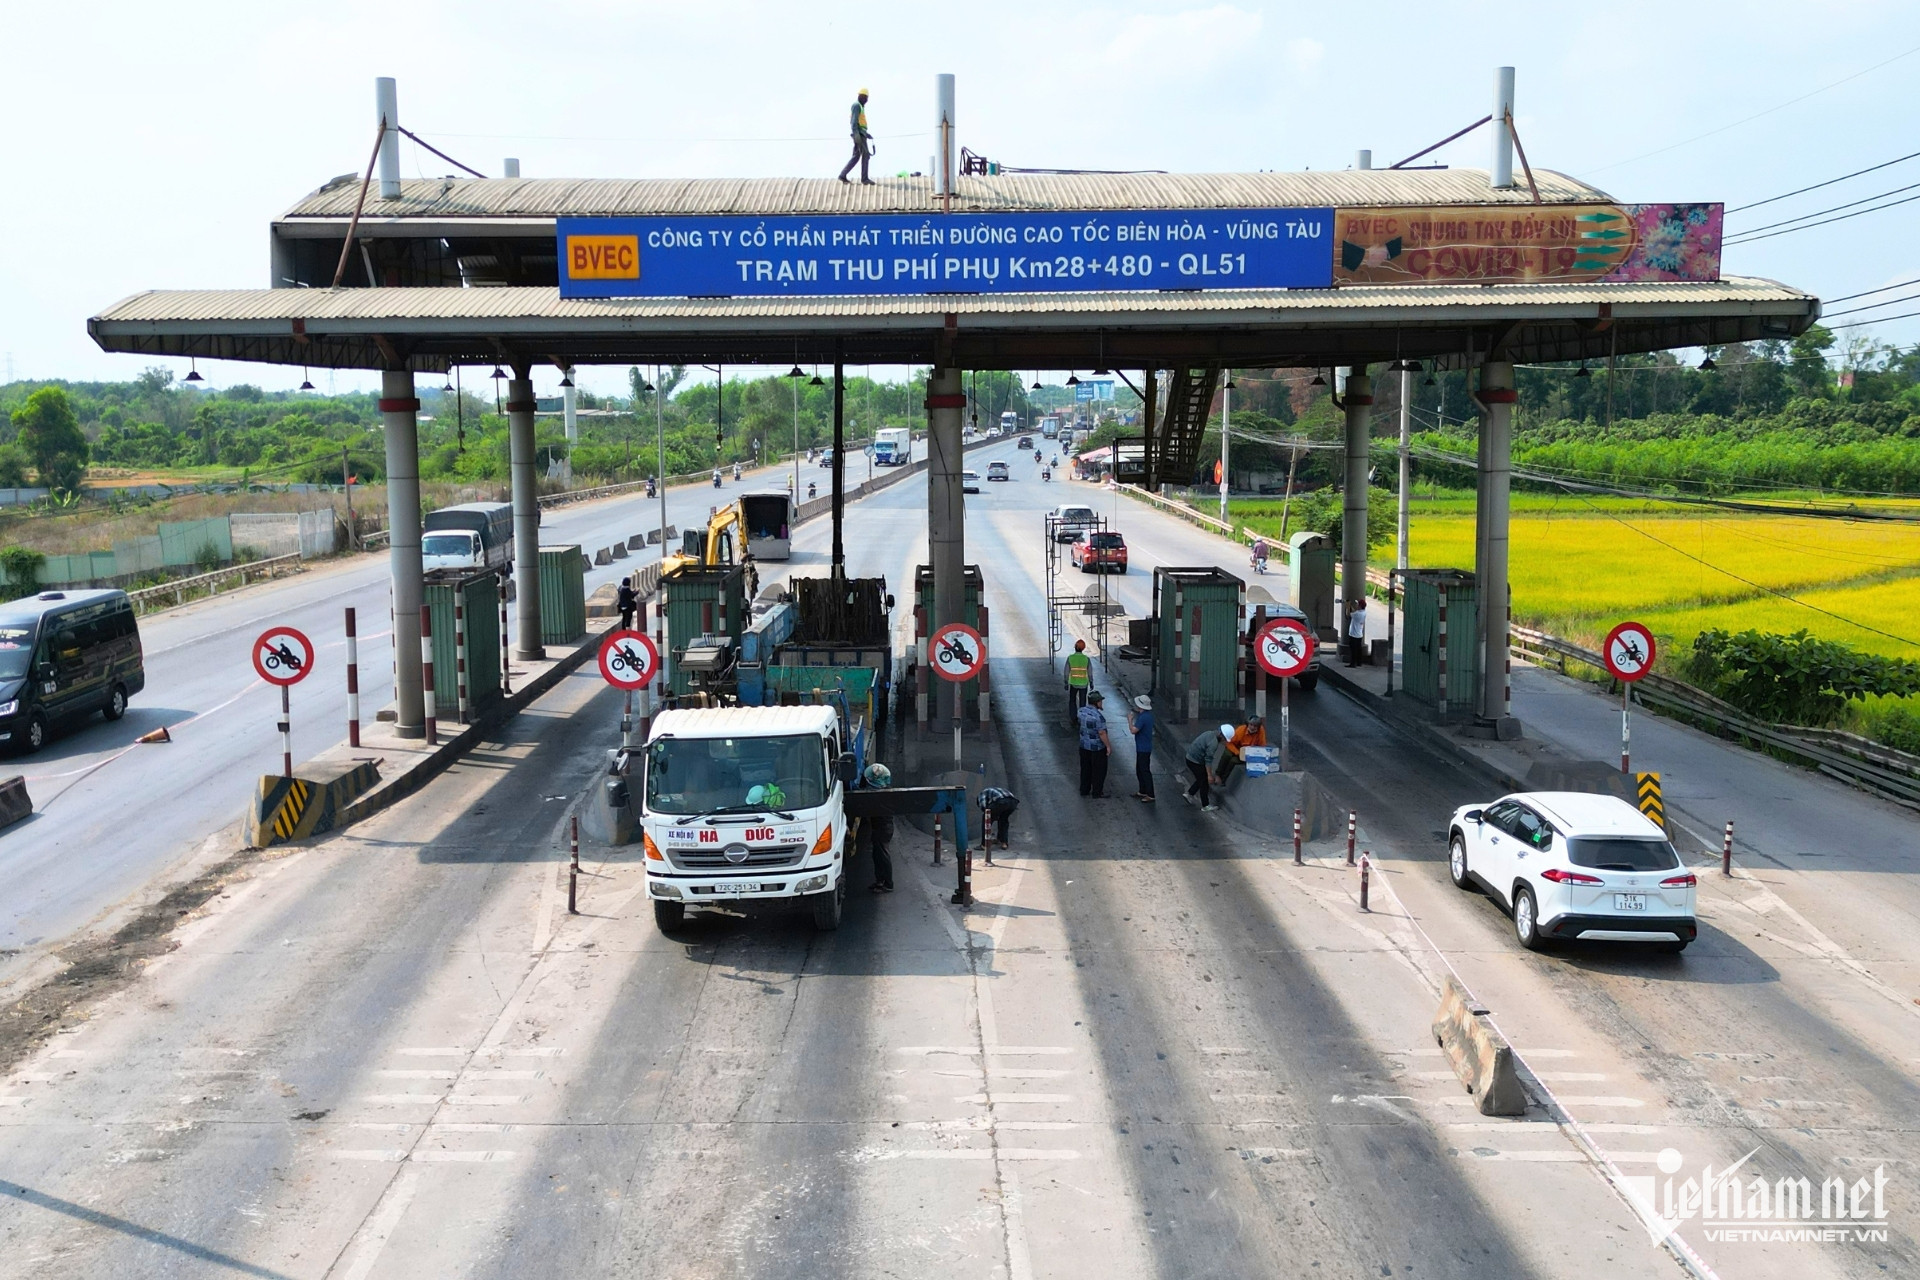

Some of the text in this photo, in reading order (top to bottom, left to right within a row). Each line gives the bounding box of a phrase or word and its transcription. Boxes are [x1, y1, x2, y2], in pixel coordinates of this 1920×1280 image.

[648, 226, 702, 248] CÔNG
[709, 230, 733, 247] TY
[740, 222, 766, 247] CỔ
[774, 223, 826, 246] PHẦN
[832, 226, 881, 246] PHÁT
[889, 220, 944, 245] TRIỂN
[950, 222, 1017, 244] ĐƯỜNG
[1024, 226, 1063, 243] CAO
[1071, 218, 1110, 241] TỐC
[1116, 222, 1160, 241] BIÊN
[1166, 220, 1206, 240] HÒA
[1226, 219, 1278, 240] VŨNG
[1286, 218, 1321, 238] TÀU
[1346, 218, 1398, 236] BVEC
[1410, 213, 1577, 240] CHUNG TAY ĐẨY LÙI
[574, 245, 633, 270] BVEC
[736, 259, 818, 286] TRẠM
[828, 258, 884, 281] THU
[894, 253, 939, 280] PHÍ
[944, 258, 1000, 285] PHỤ
[1009, 254, 1153, 278] Km28+480
[1178, 253, 1246, 276] QL51
[1407, 247, 1577, 276] COVID-19
[746, 826, 774, 841] ĐỨC
